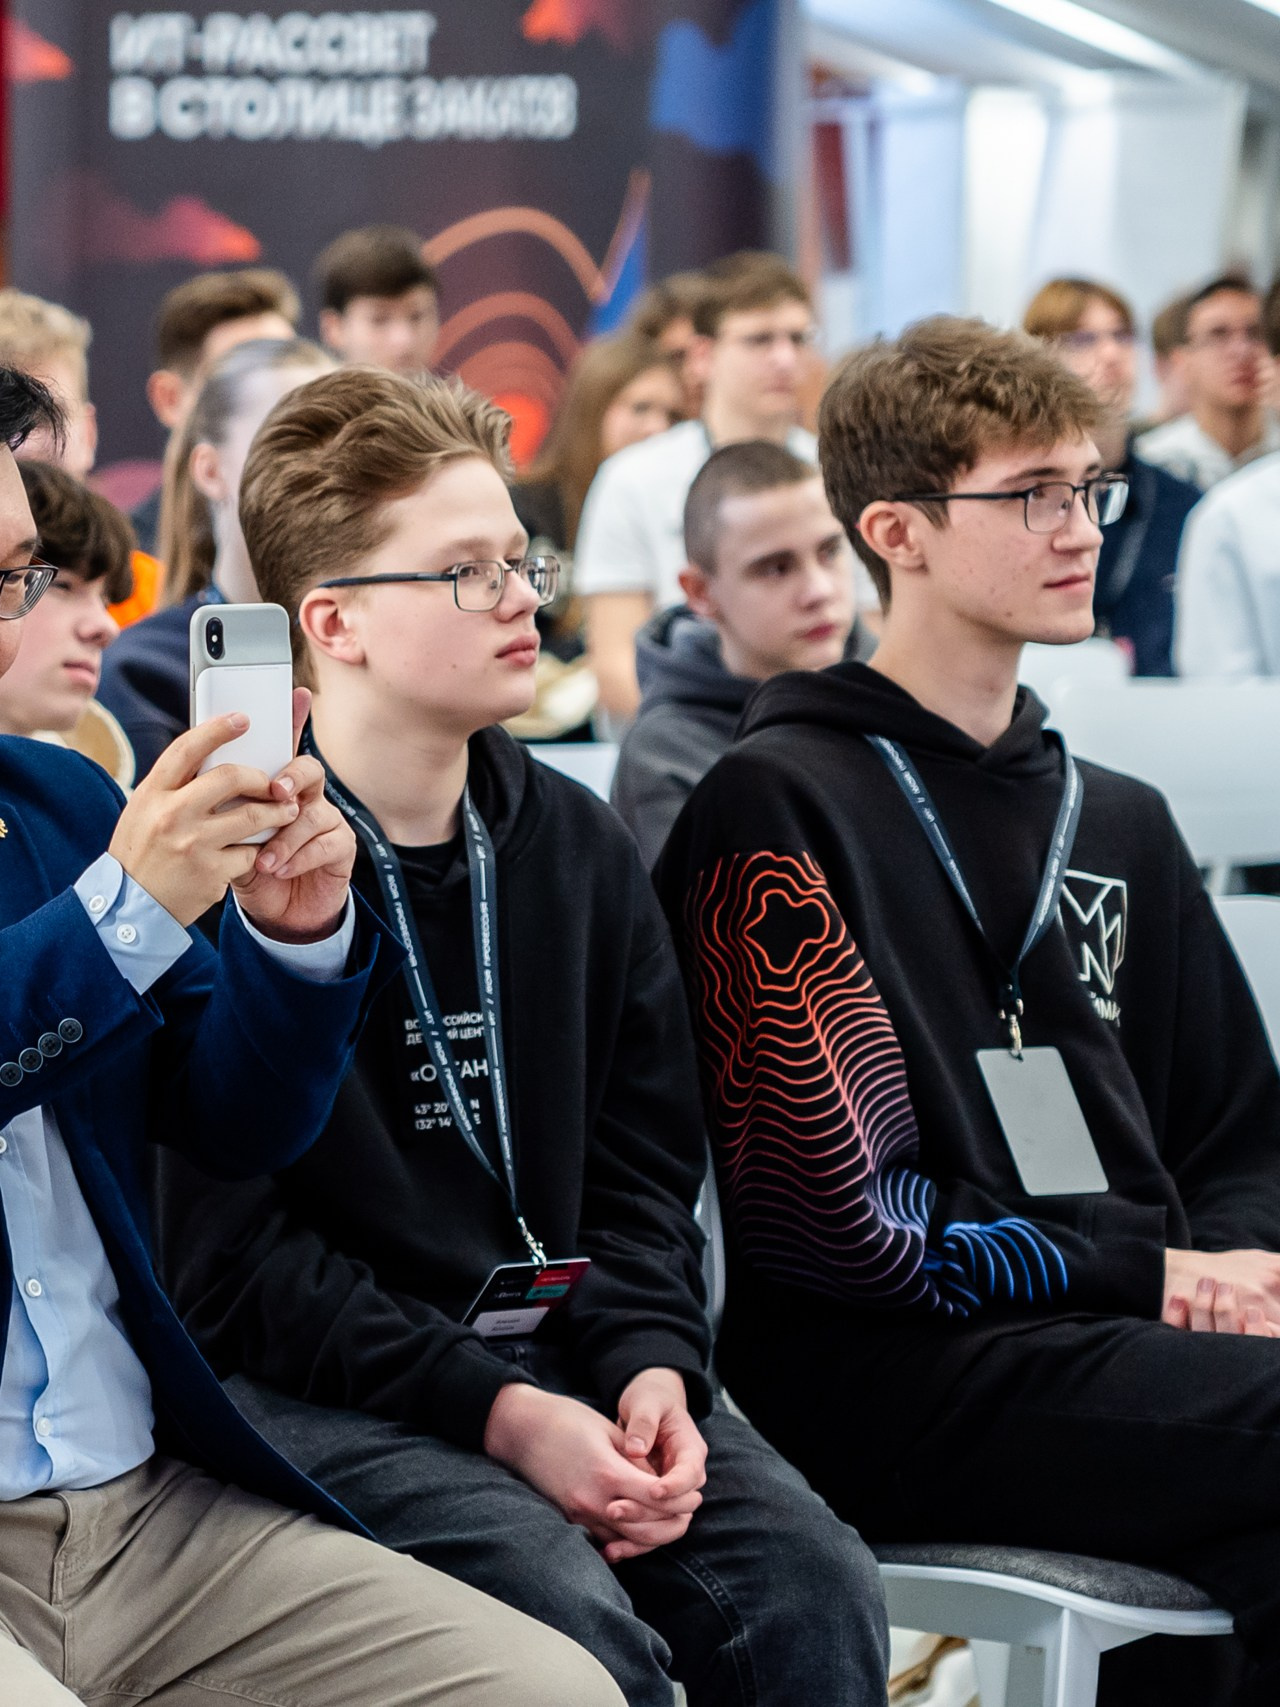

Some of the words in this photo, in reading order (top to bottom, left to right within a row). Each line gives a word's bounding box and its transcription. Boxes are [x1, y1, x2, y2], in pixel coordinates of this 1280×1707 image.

[111, 12, 435, 73] ИТ-РАССВЕТ
[110, 76, 156, 140] В
[159, 76, 399, 149] СТОЛИЦЕ
[325, 778, 356, 817] ФЕССИЯ
[386, 874, 399, 899] МОЯ
